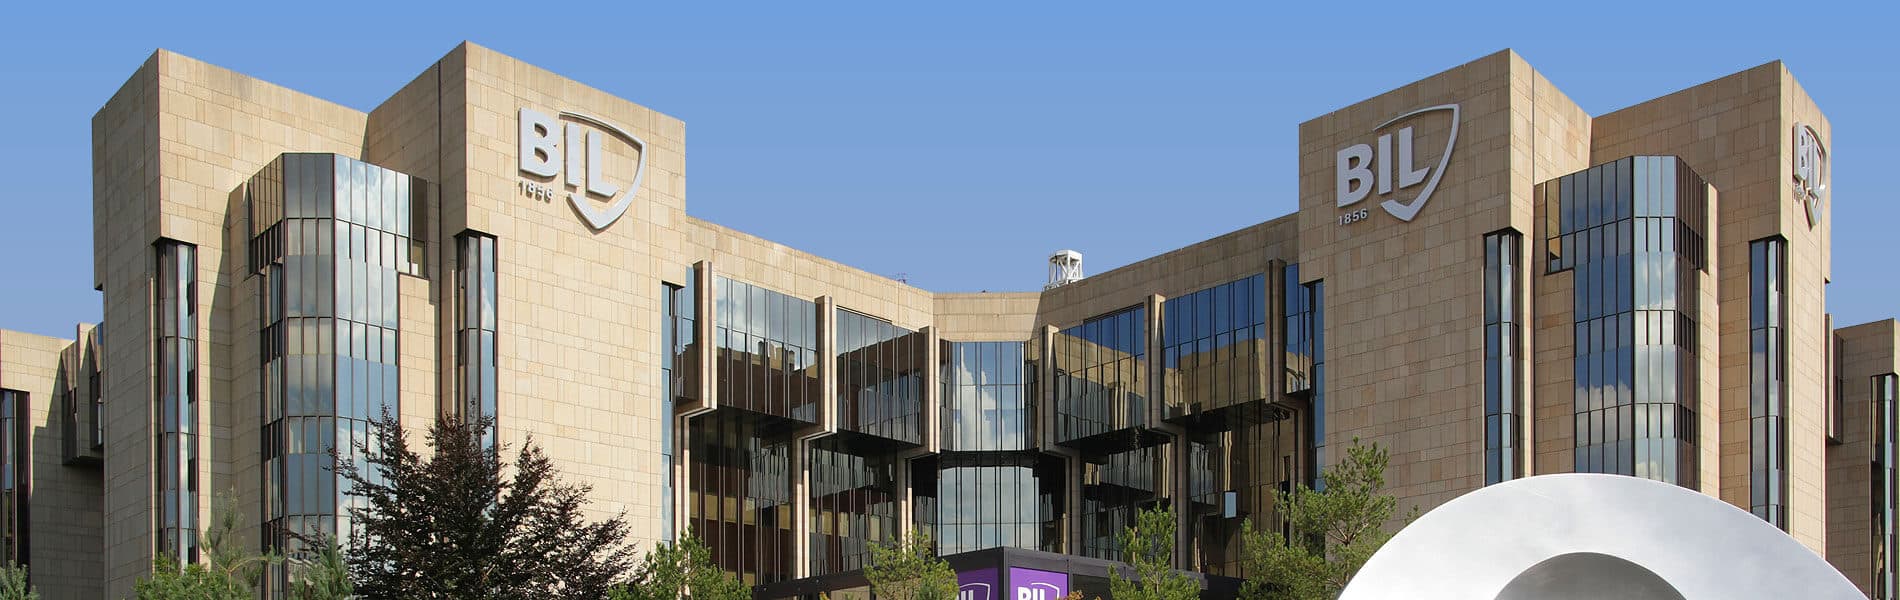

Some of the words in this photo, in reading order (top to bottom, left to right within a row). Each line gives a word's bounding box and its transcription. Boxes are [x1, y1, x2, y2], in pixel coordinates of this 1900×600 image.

[518, 107, 619, 198] BIL
[1337, 126, 1431, 208] BIL
[518, 178, 553, 204] 1856
[1338, 207, 1368, 226] 1856
